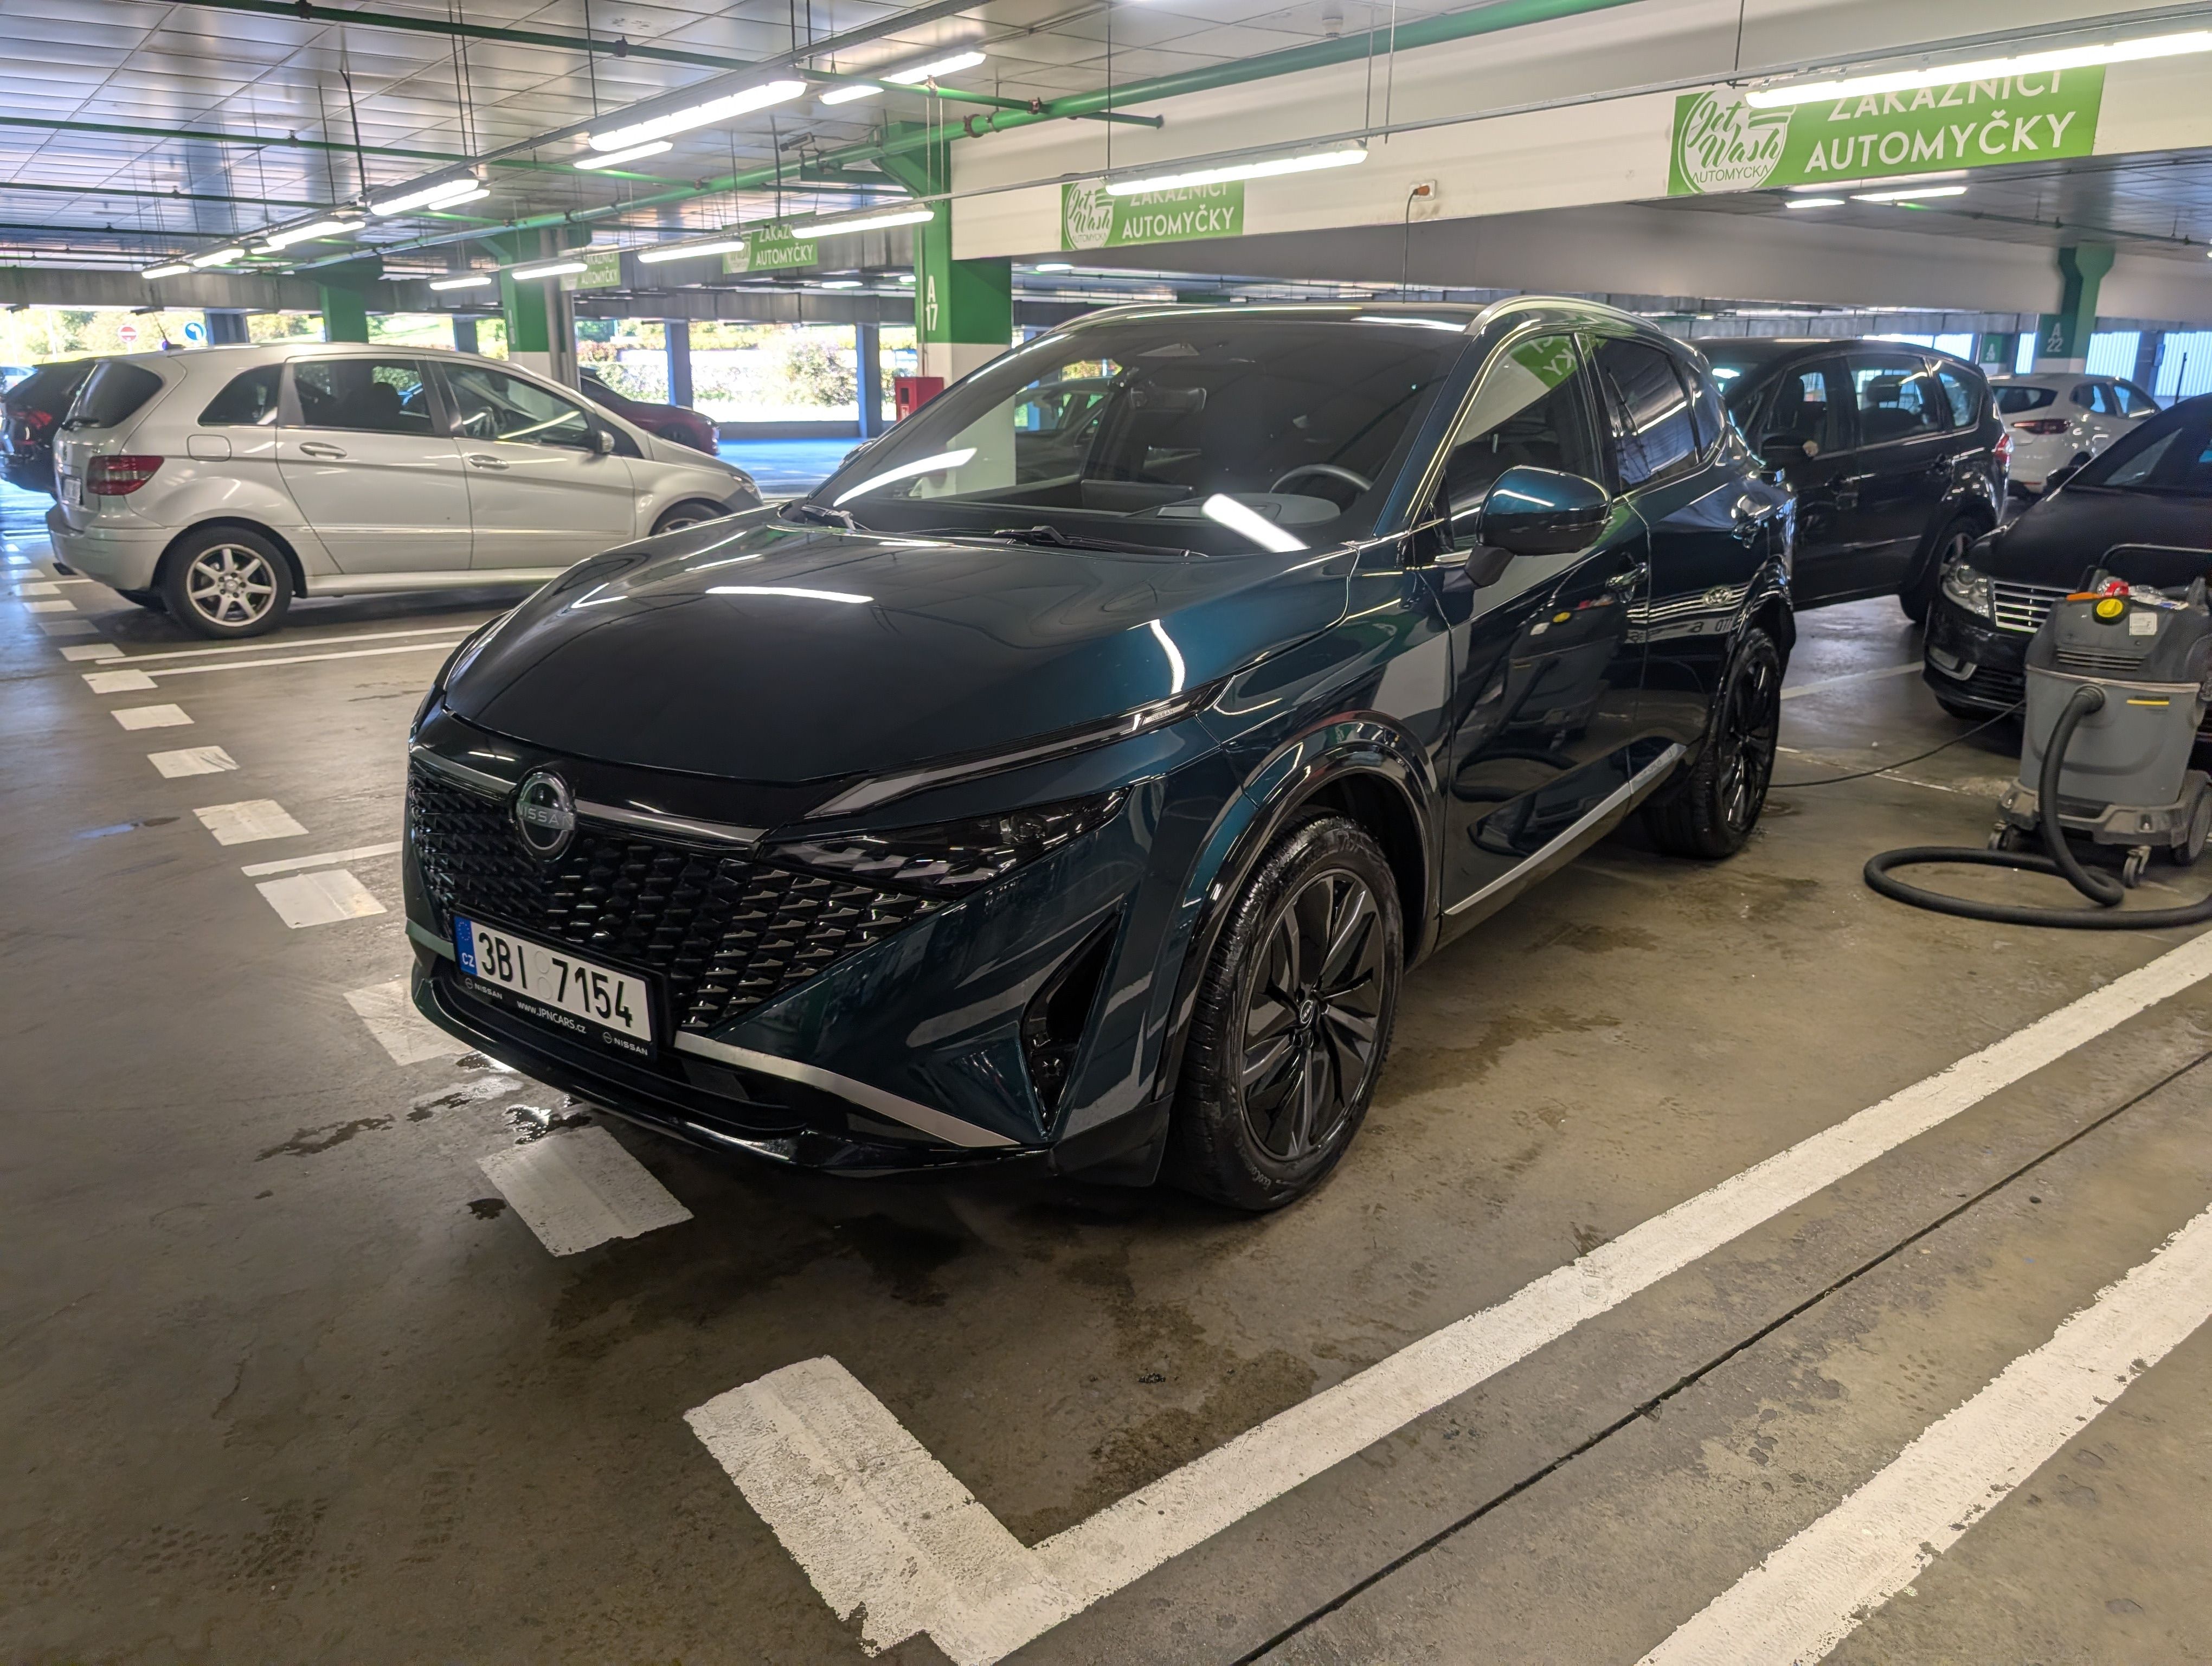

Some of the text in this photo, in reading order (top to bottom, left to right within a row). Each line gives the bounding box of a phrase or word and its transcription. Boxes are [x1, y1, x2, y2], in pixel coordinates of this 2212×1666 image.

[1687, 101, 1746, 148] Jet
[1699, 123, 1779, 168] Wash
[1804, 109, 2076, 174] AUTOMYČKY
[1122, 204, 1234, 239] AUTOMYČKY
[755, 242, 814, 266] AUTOMYČKY
[927, 275, 936, 303] A
[925, 303, 938, 331] 17
[2052, 322, 2061, 338] A
[2046, 337, 2063, 353] 22
[516, 802, 574, 827] NISSAN
[462, 952, 475, 967] CZ
[474, 983, 503, 999] NISSAN
[478, 932, 633, 1028] 3BI 7154
[516, 1001, 587, 1034] www.JPNCARS.cz
[614, 1037, 648, 1056] NISSAN
